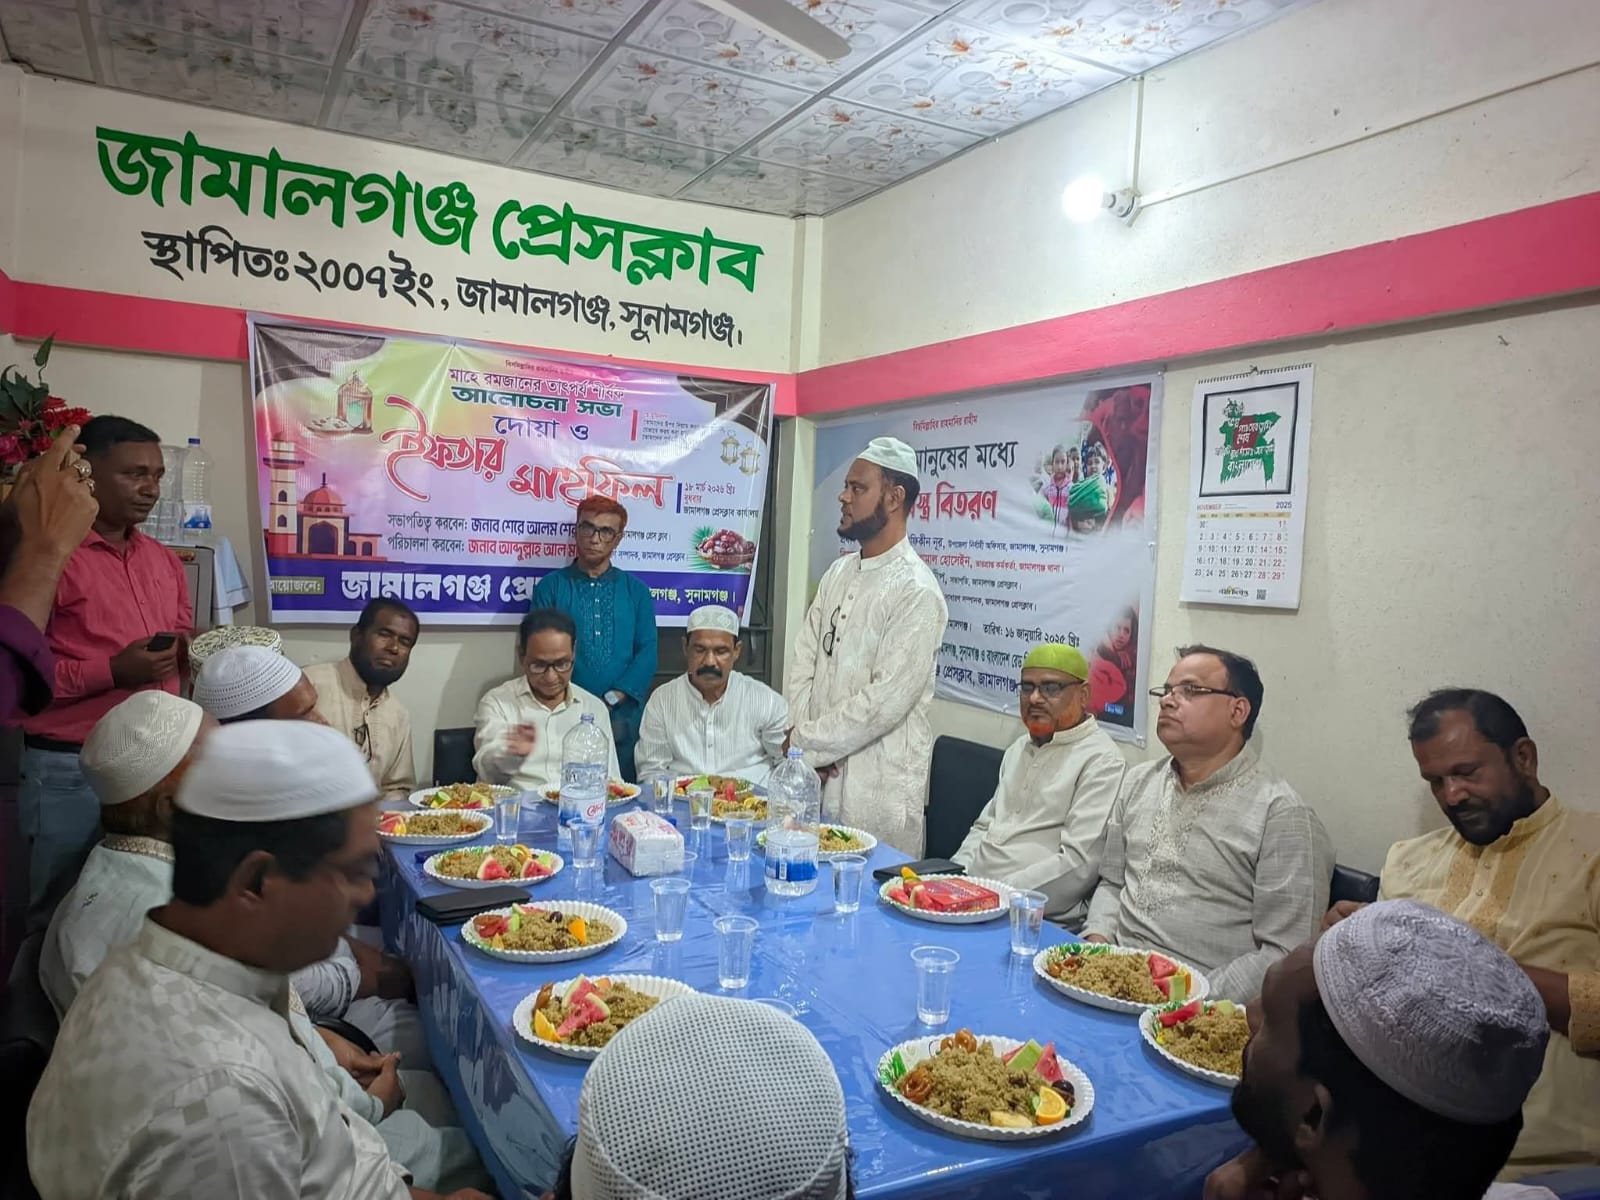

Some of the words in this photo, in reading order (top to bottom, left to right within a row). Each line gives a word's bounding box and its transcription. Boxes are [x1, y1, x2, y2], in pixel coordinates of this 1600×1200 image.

[96, 126, 478, 255] জামালগঞ্জ
[492, 199, 764, 293] প্রেসক্লাব
[449, 368, 479, 385] মাহে
[484, 373, 542, 391] রমজানের
[546, 379, 588, 397] তাৎপর্য
[451, 386, 569, 413] আলোচনা
[576, 400, 623, 417] সভা
[493, 414, 560, 440] দোয়া
[382, 396, 507, 500] ইফতার
[975, 441, 1018, 469] মধ্যে
[936, 481, 998, 522] বিতরণ
[1276, 501, 1292, 509] 2025
[471, 517, 500, 534] জনাব
[502, 519, 525, 536] শেরে
[527, 521, 558, 536] আলম
[468, 539, 497, 555] জনাব
[543, 541, 566, 557] আল
[341, 571, 491, 603] জামালগঞ্জ
